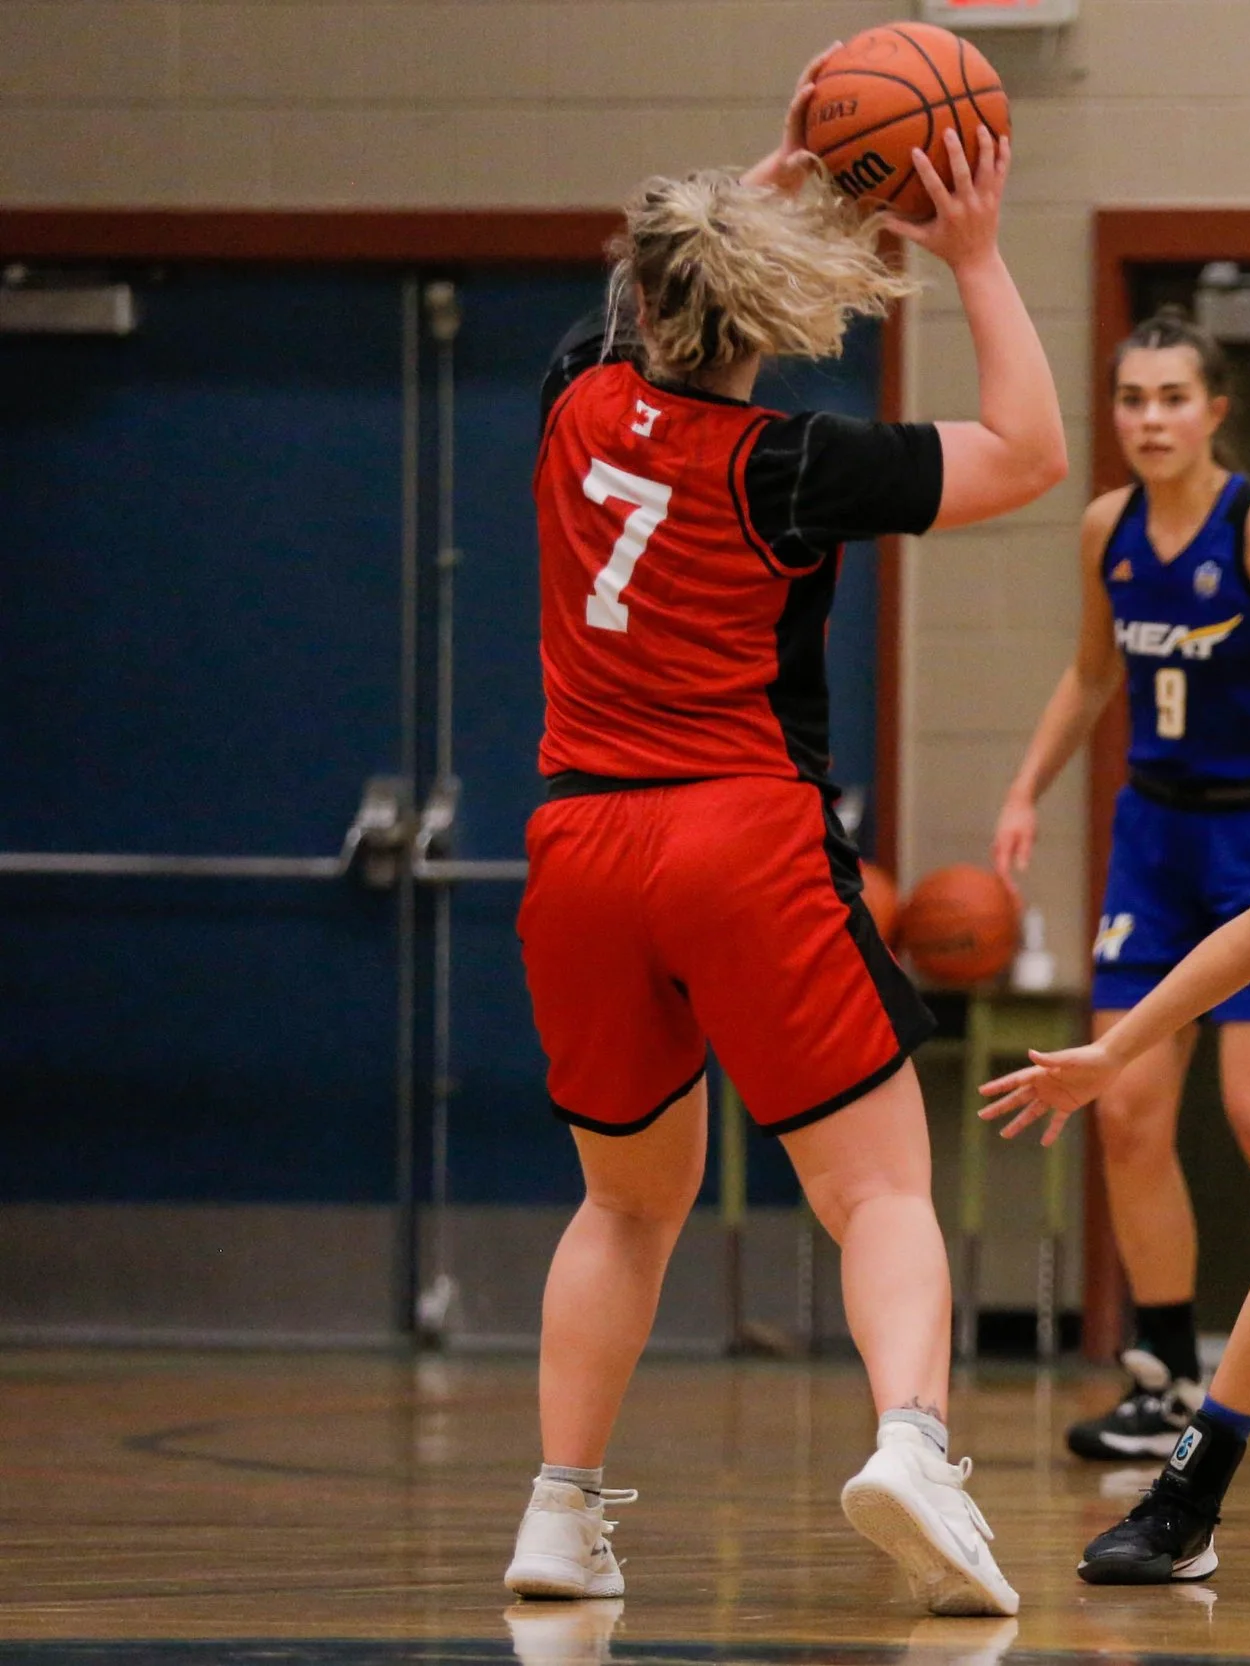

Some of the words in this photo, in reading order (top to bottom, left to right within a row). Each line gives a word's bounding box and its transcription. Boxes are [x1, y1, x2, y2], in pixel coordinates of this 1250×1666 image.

[582, 457, 672, 633] 7
[1114, 616, 1236, 660] HEAT
[1155, 668, 1187, 739] 9
